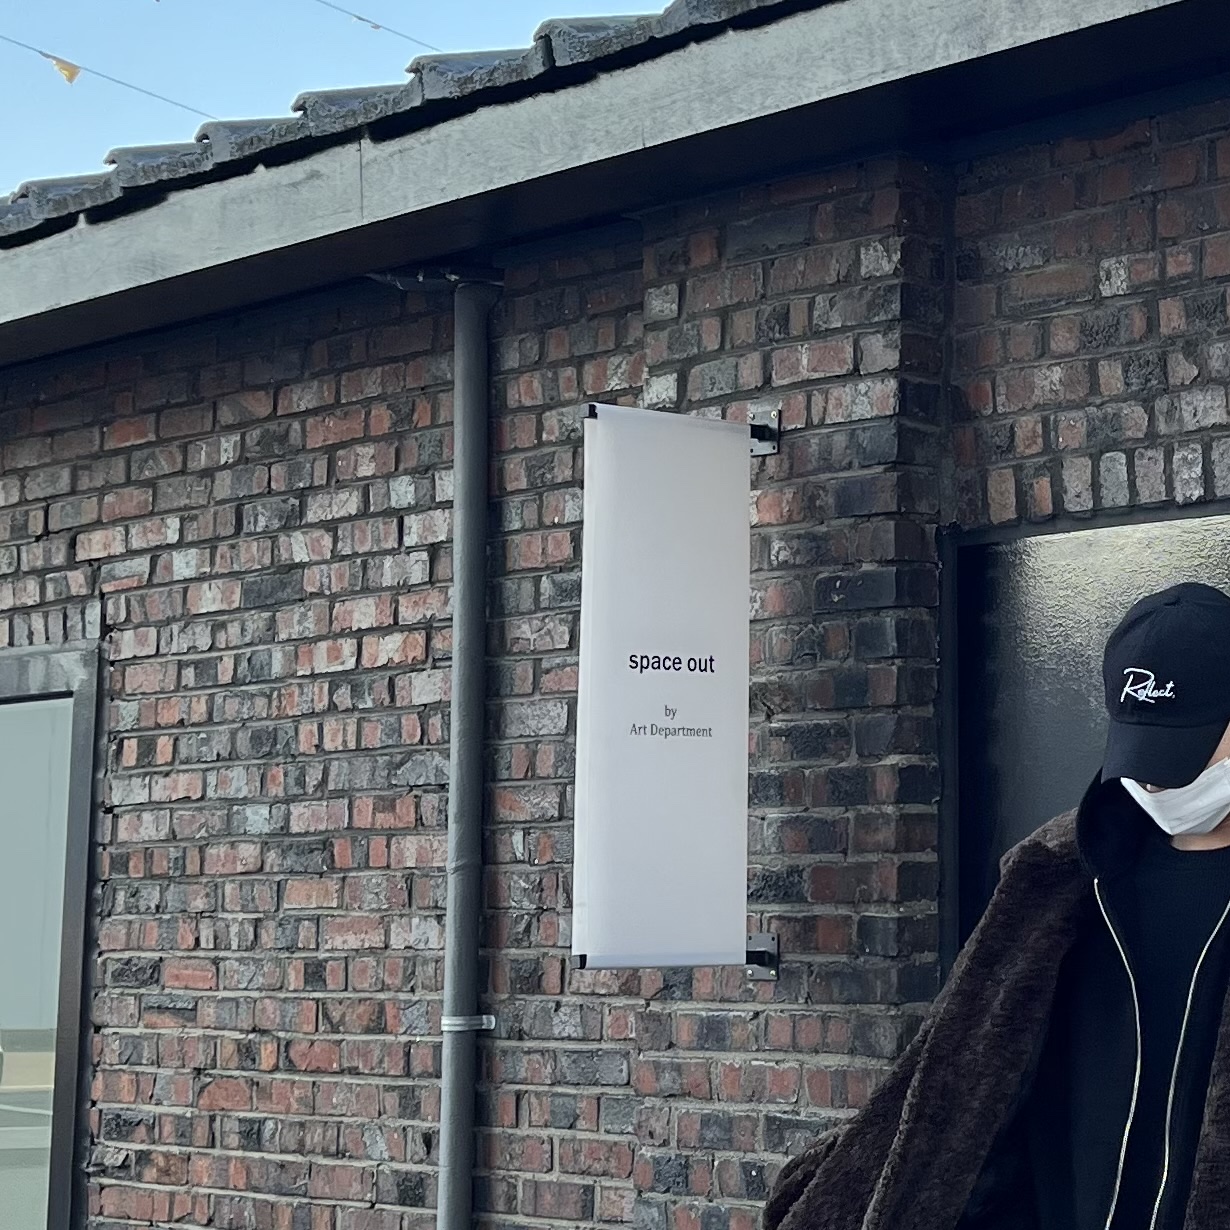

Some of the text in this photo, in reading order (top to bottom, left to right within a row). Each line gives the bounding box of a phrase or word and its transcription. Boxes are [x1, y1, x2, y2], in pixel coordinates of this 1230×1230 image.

[629, 654, 715, 674] space out
[664, 704, 677, 721] by
[630, 723, 713, 740] Art Department
